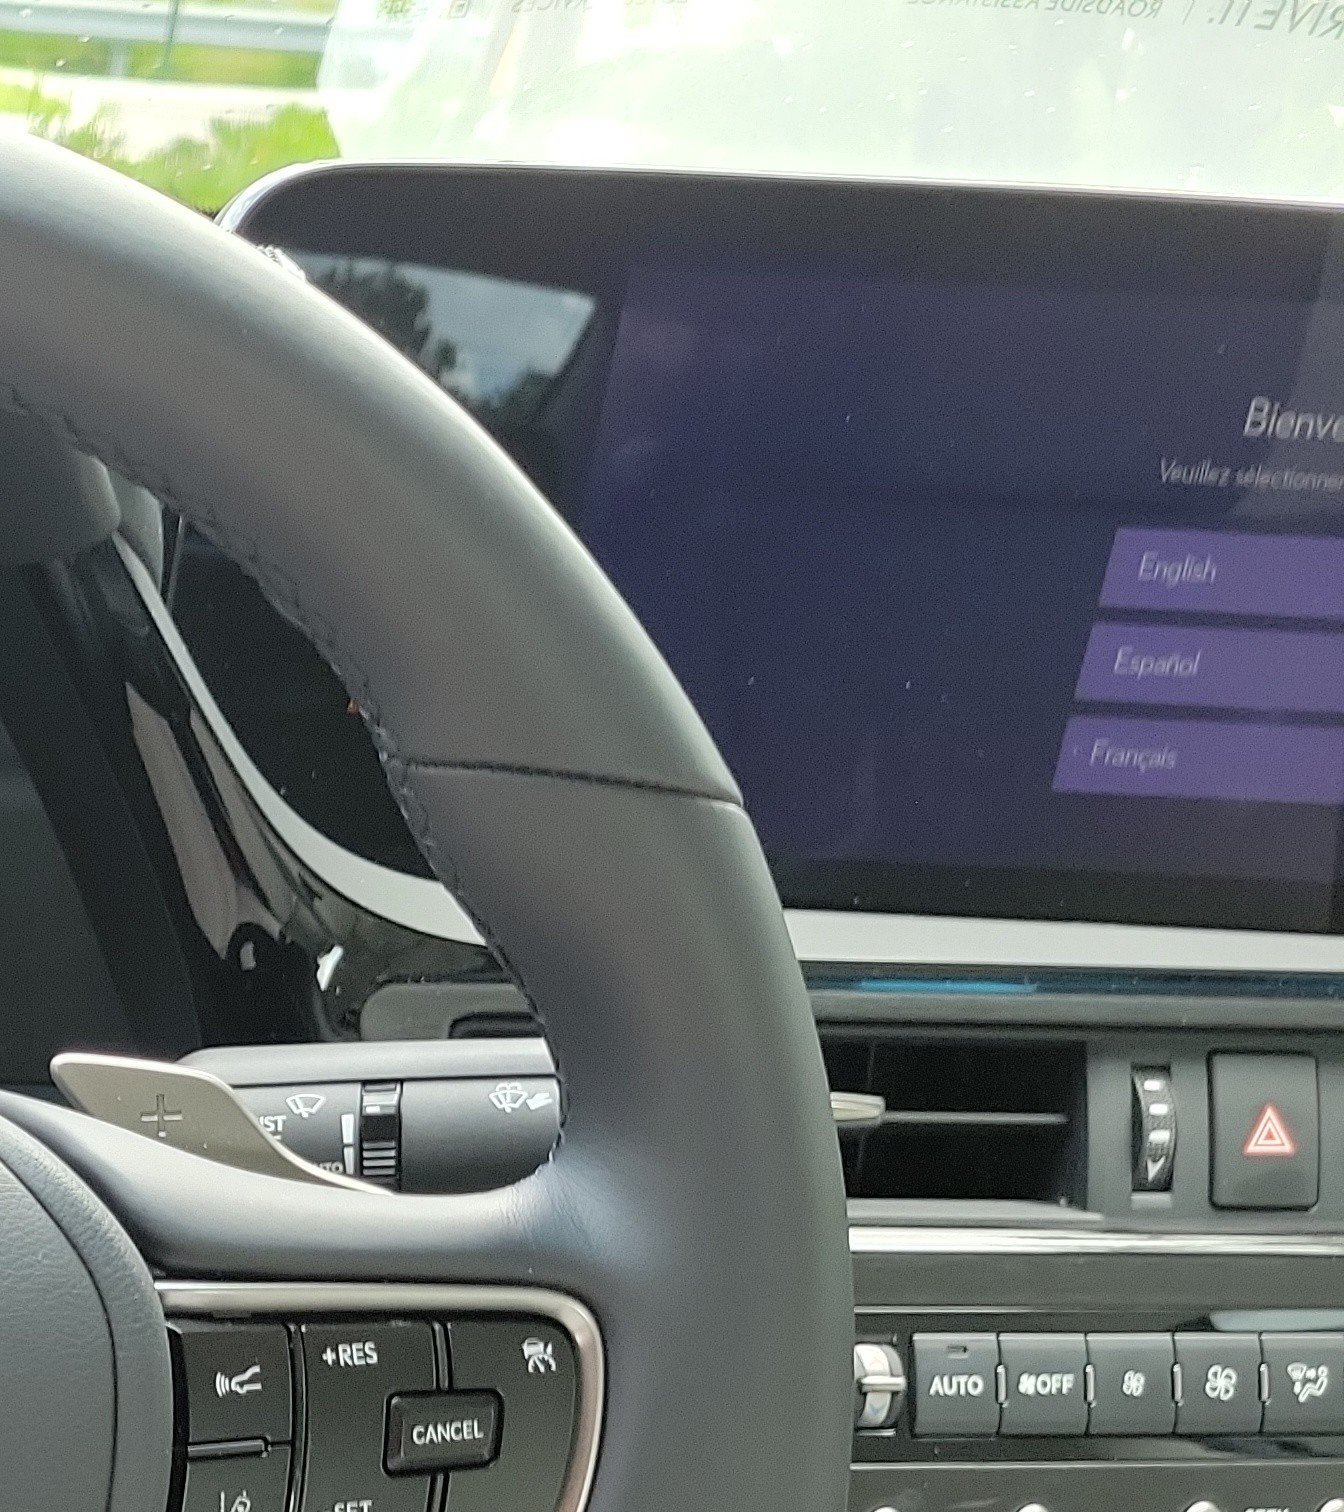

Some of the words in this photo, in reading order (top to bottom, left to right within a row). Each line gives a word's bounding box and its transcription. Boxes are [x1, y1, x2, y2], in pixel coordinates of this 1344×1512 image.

[1138, 551, 1217, 588] English
[1114, 646, 1202, 679] Español
[1090, 739, 1177, 773] Français
[929, 1373, 984, 1398] AUTO
[1034, 1372, 1075, 1397] OFF
[412, 1420, 484, 1446] CANCEL
